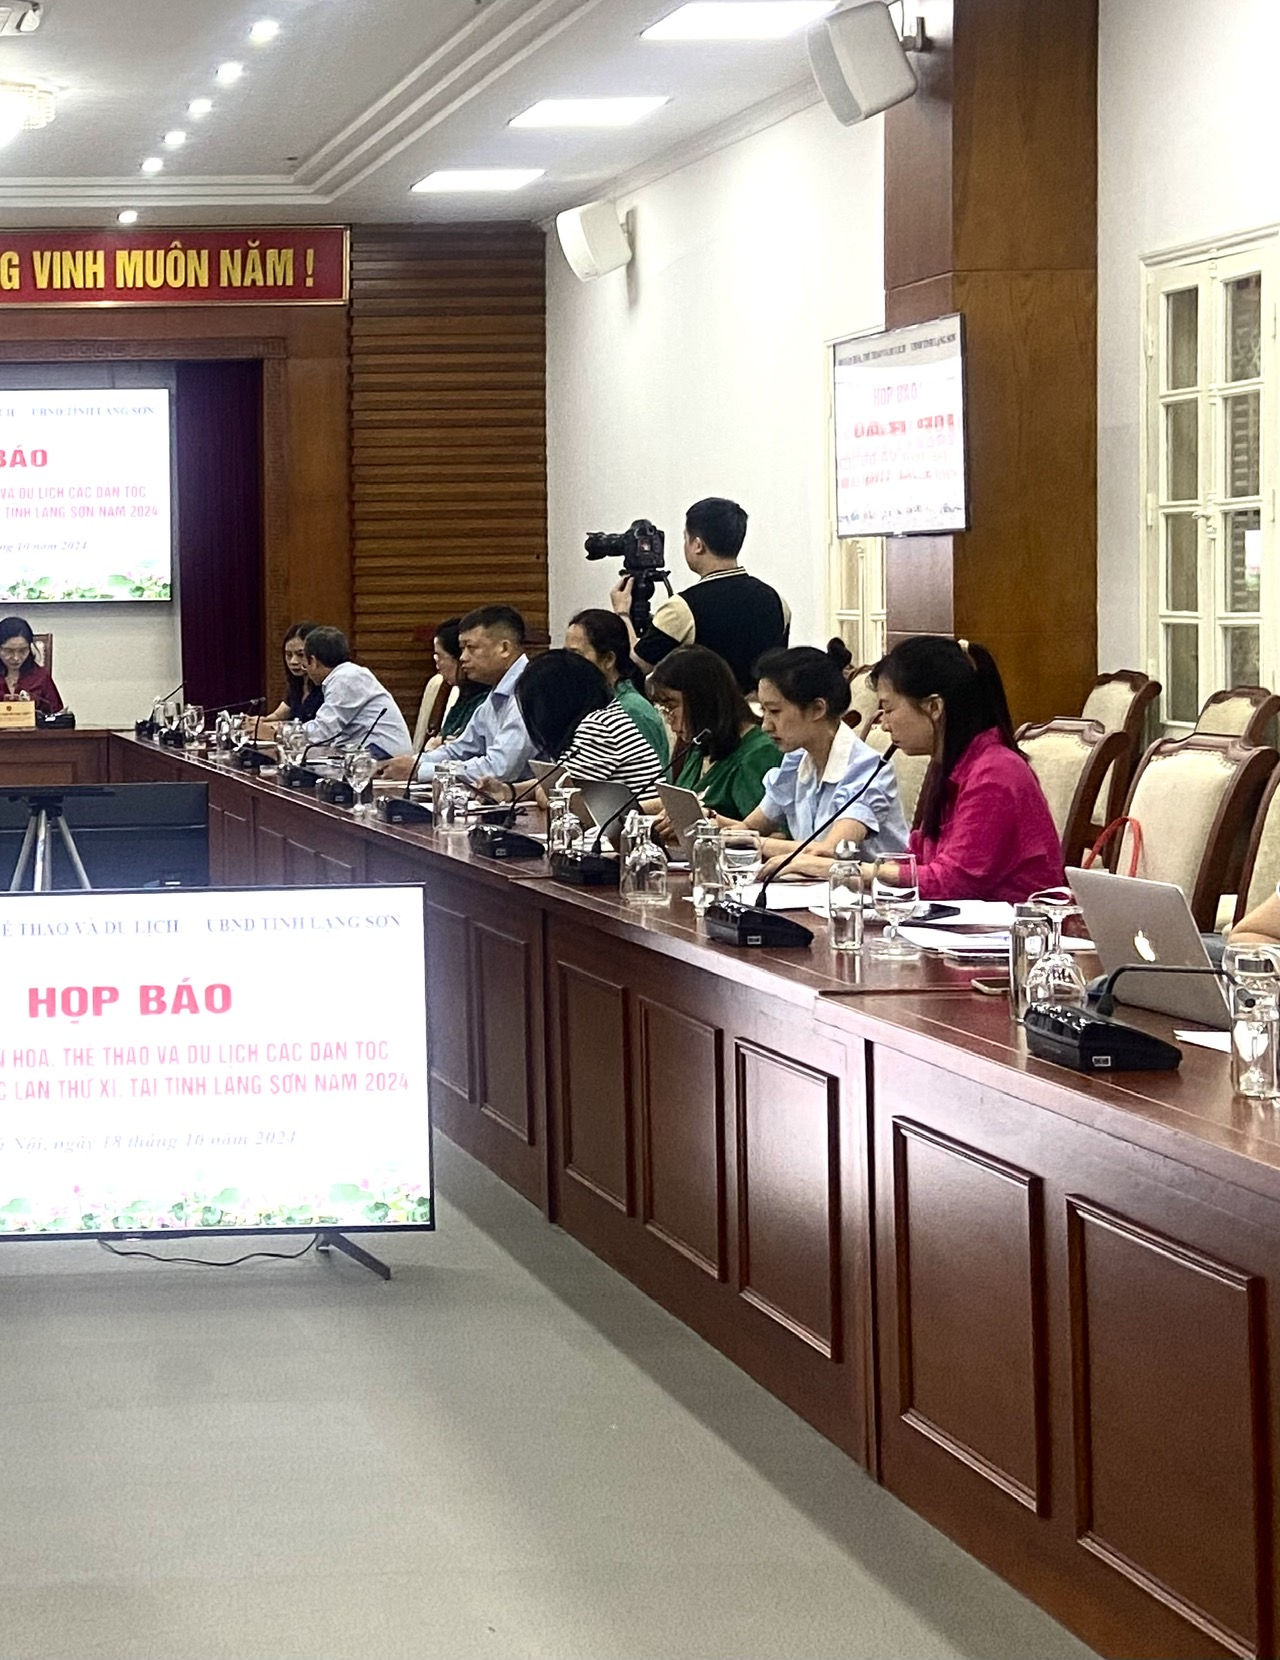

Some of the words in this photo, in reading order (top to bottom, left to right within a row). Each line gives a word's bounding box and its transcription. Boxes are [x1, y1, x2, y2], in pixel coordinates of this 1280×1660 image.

[32, 250, 106, 289] VINH
[115, 242, 209, 289] MUÔN
[220, 239, 294, 287] NĂM
[21, 922, 69, 937] THAO
[104, 921, 126, 934] DU
[206, 918, 255, 933] UBND
[27, 985, 120, 1025] HỌP
[138, 976, 233, 1016] BÁO
[102, 1045, 150, 1066] THAO
[187, 1044, 211, 1064] DU
[365, 1072, 409, 1092] 2024
